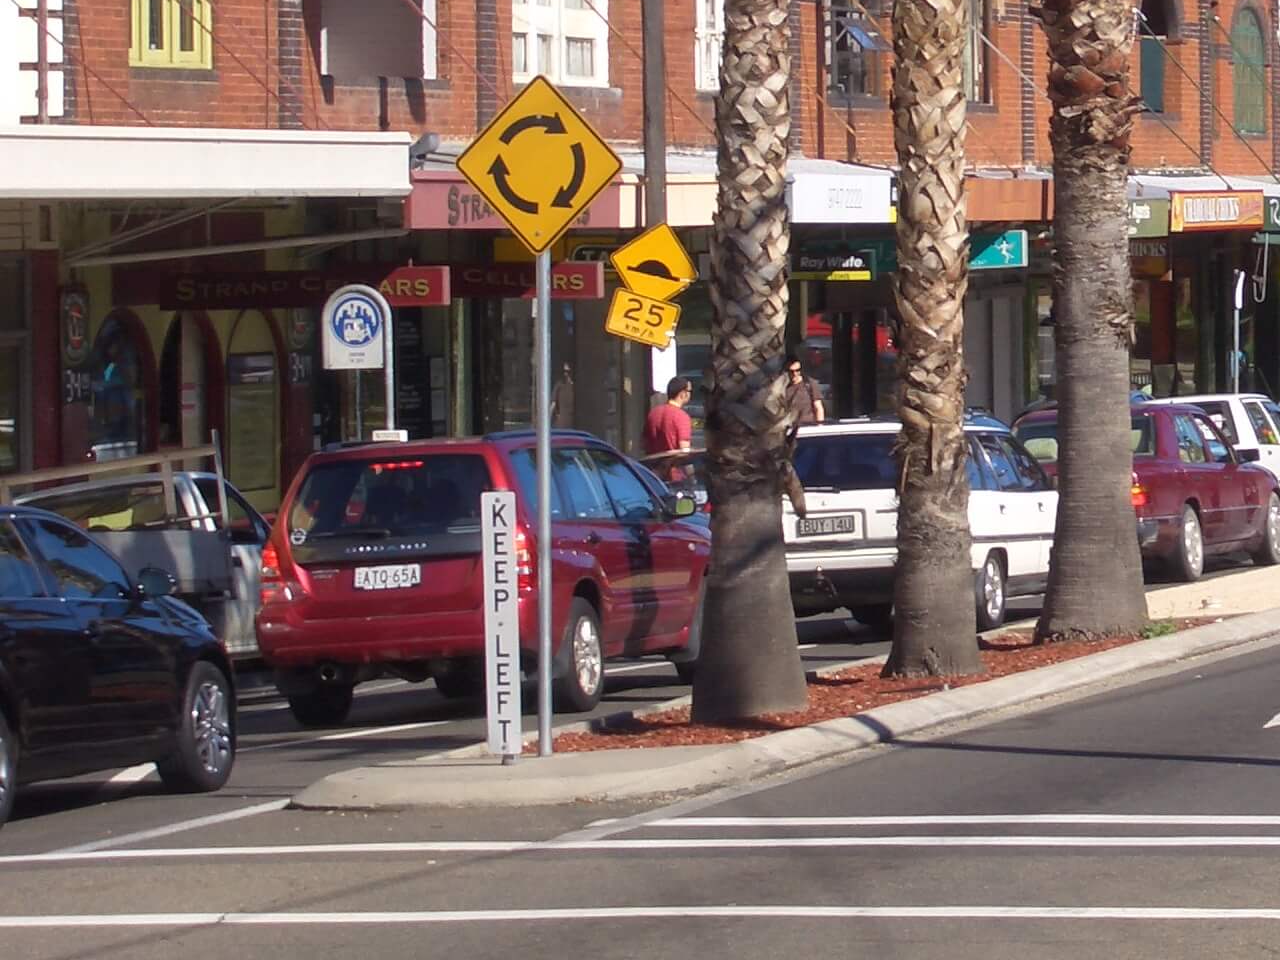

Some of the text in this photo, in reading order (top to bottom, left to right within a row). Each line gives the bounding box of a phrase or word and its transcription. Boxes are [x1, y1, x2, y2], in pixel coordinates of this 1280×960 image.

[447, 185, 496, 226] STRA
[800, 256, 824, 270] Ray
[299, 276, 430, 297] CEARS
[464, 268, 585, 291] CELLRS
[624, 298, 665, 328] 25
[625, 323, 655, 339] km/h
[491, 503, 509, 612] KEEP
[495, 634, 511, 743] LEFT
